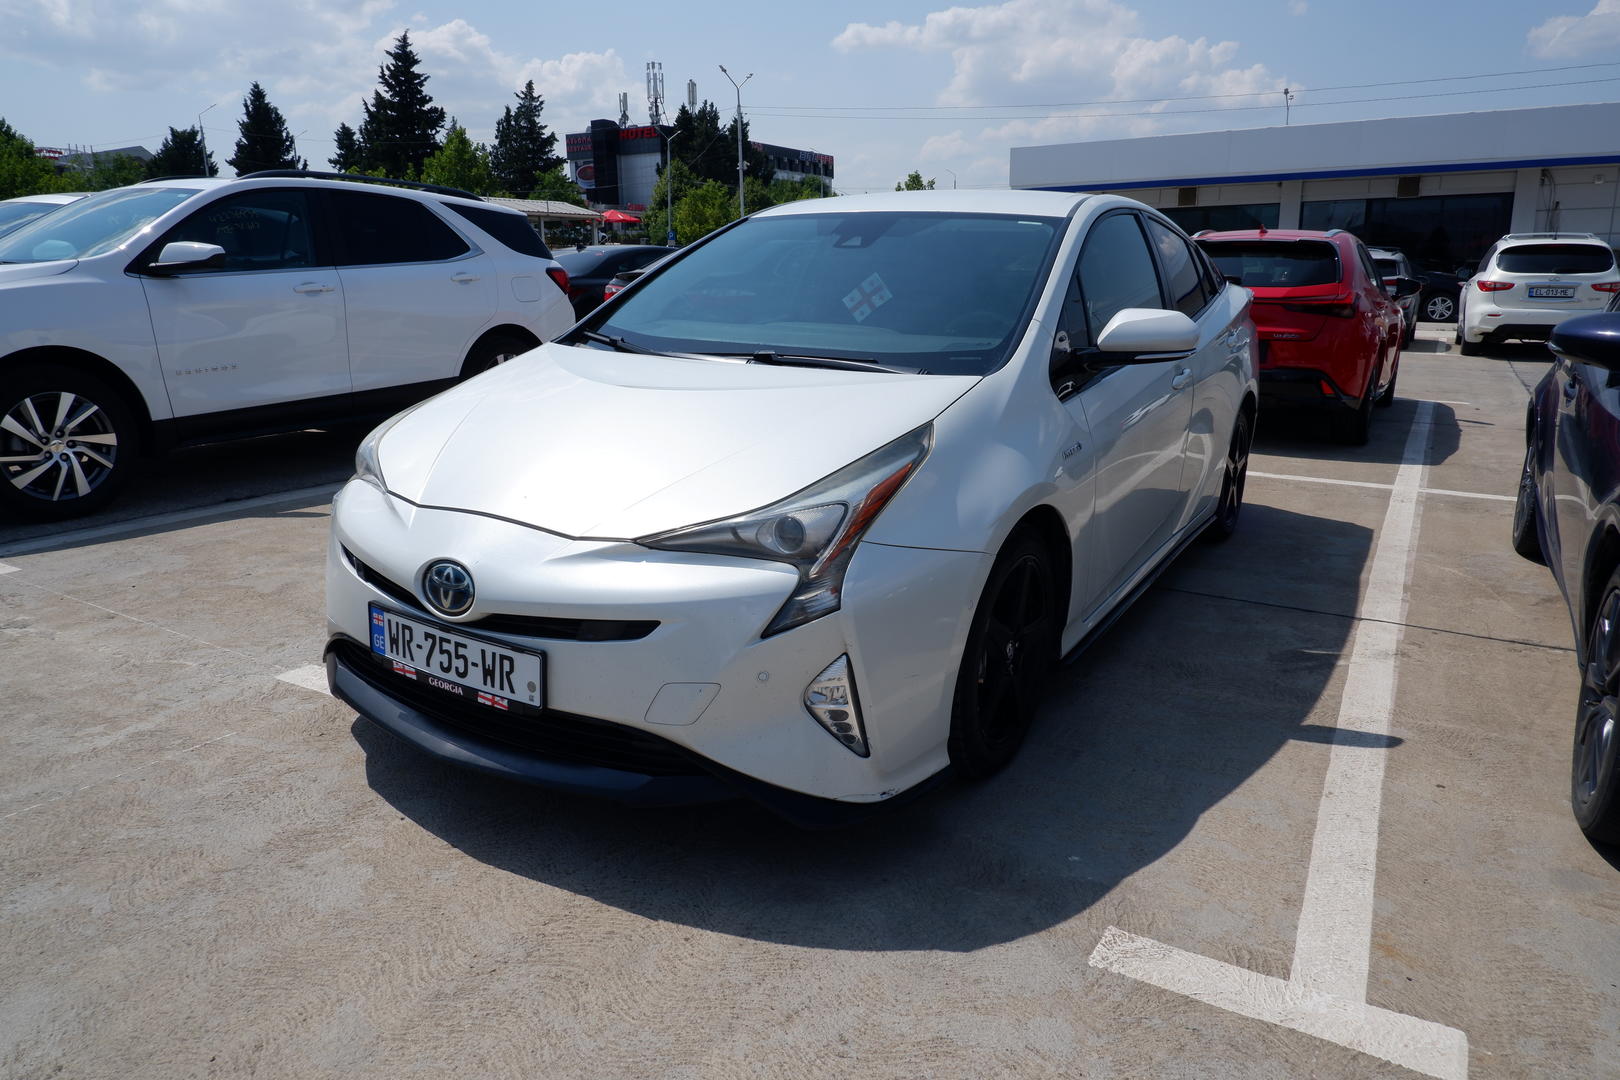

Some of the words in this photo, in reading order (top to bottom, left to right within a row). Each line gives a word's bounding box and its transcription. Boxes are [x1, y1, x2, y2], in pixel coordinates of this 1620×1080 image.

[619, 126, 658, 139] HOTEL
[373, 633, 385, 650] GE
[387, 618, 516, 695] WR-755-WR
[428, 676, 464, 696] GEORGIA
